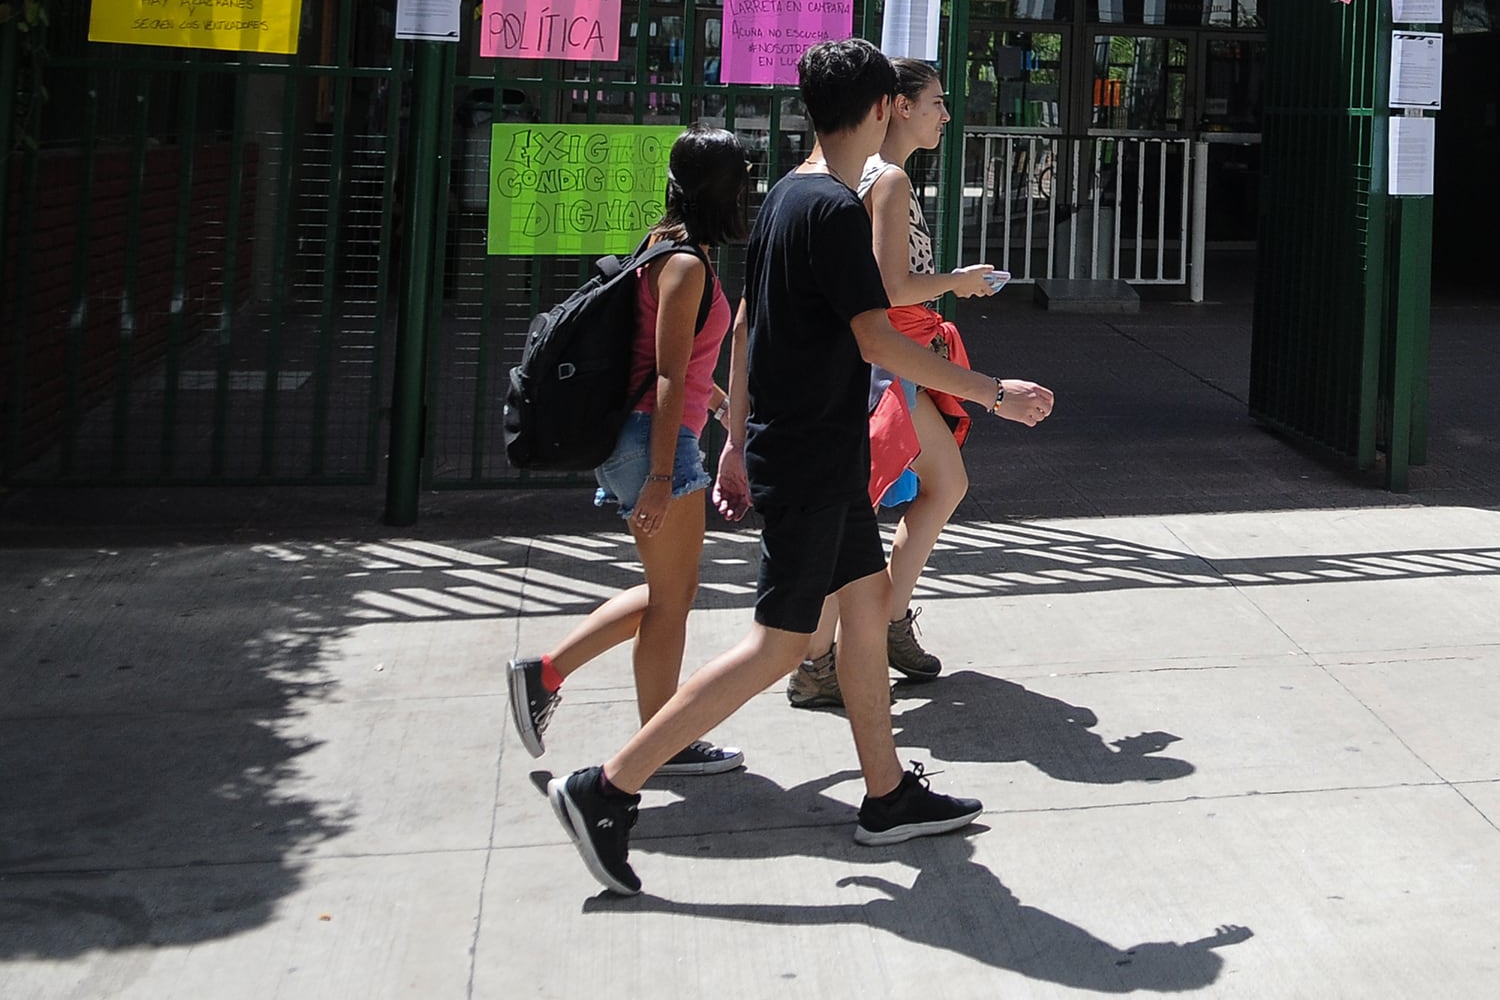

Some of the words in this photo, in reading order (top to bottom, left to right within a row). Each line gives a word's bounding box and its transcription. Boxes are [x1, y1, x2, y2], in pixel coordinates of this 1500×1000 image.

[188, 6, 195, 16] Y
[786, 0, 801, 13] EN
[808, 1, 851, 15] CAMPAÑA
[178, 20, 199, 30] LOS
[489, 7, 604, 52] POLÍTICA
[768, 28, 782, 38] NO
[786, 28, 830, 39] ESCUCHA
[758, 57, 773, 67] EN
[523, 199, 665, 237] DIGNAS
